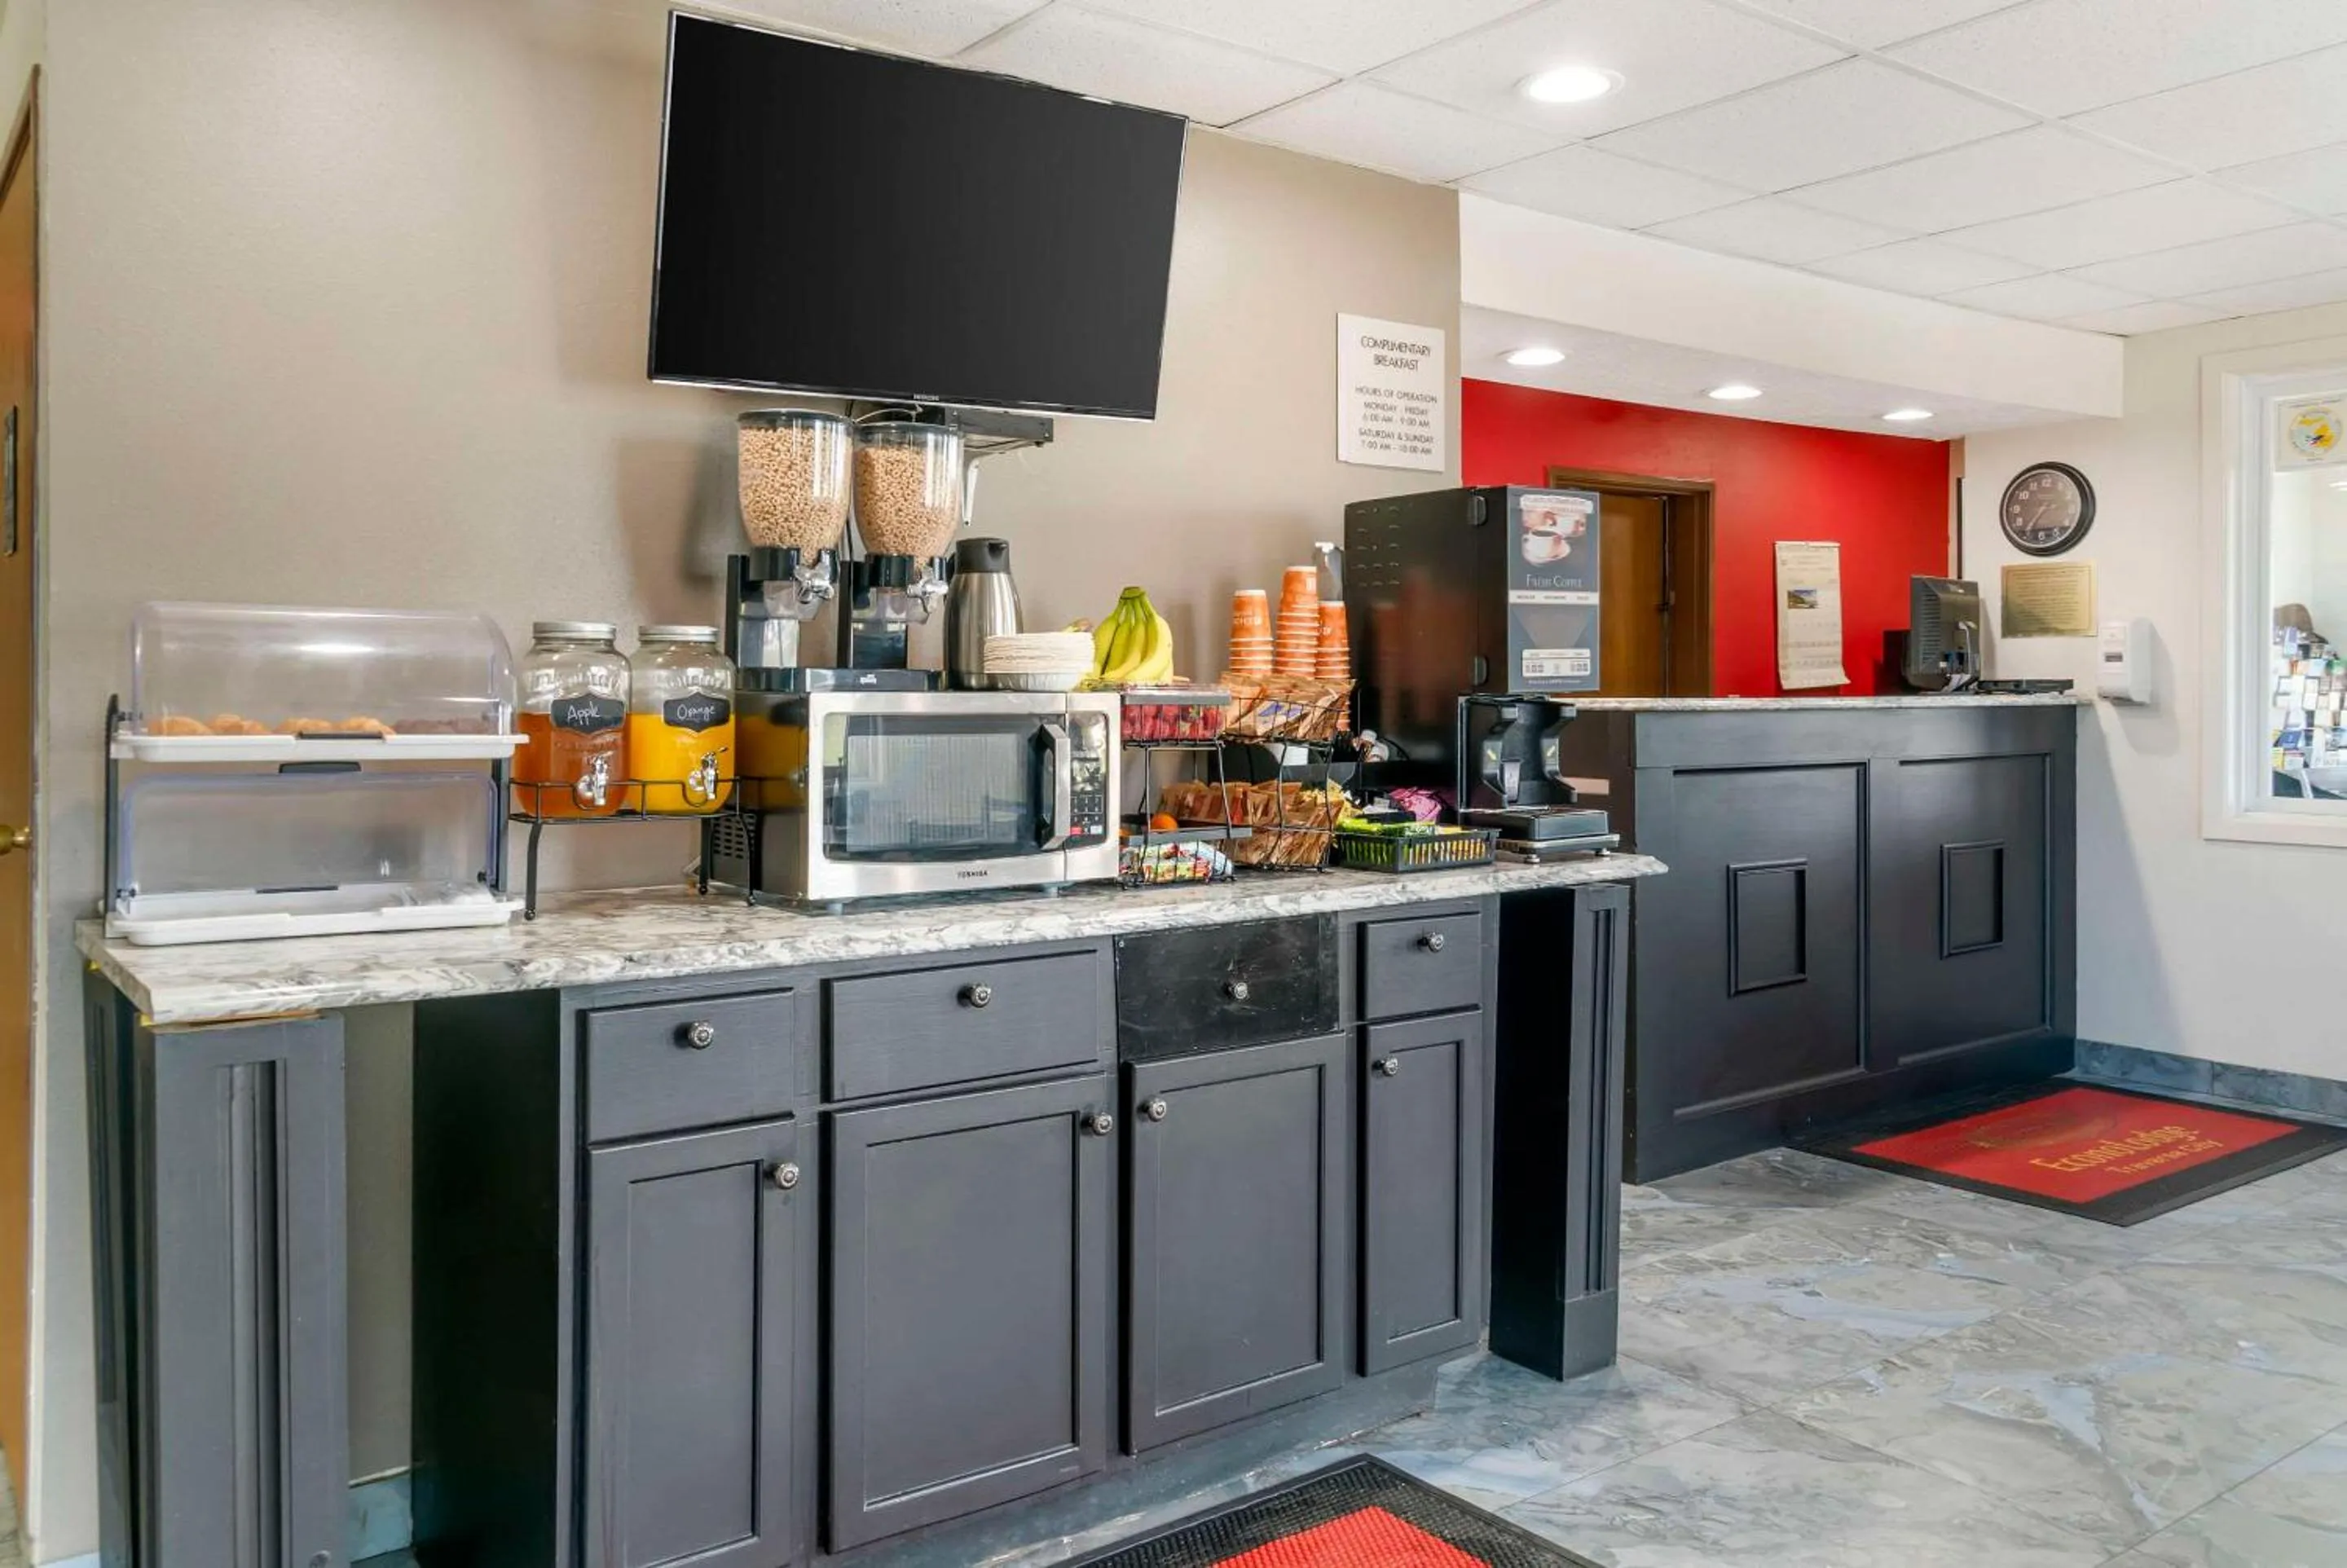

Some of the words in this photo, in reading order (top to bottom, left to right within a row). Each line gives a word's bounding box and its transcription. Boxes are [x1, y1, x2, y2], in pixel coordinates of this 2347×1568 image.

[1360, 335, 1431, 356] COMPLIMENTARY
[1373, 354, 1419, 372] BREAKFAST
[1355, 385, 1382, 397] HOURS
[1384, 389, 1394, 399] OF
[1396, 390, 1438, 403] OPERATION
[1363, 402, 1397, 412] MONDAY
[1404, 406, 1428, 416] FRIDAY
[1358, 428, 1395, 439] SATURDAY
[1404, 433, 1434, 443] SUNDAY
[2019, 491, 2029, 500] 10
[567, 701, 600, 726] Apple
[676, 703, 716, 722] Orange
